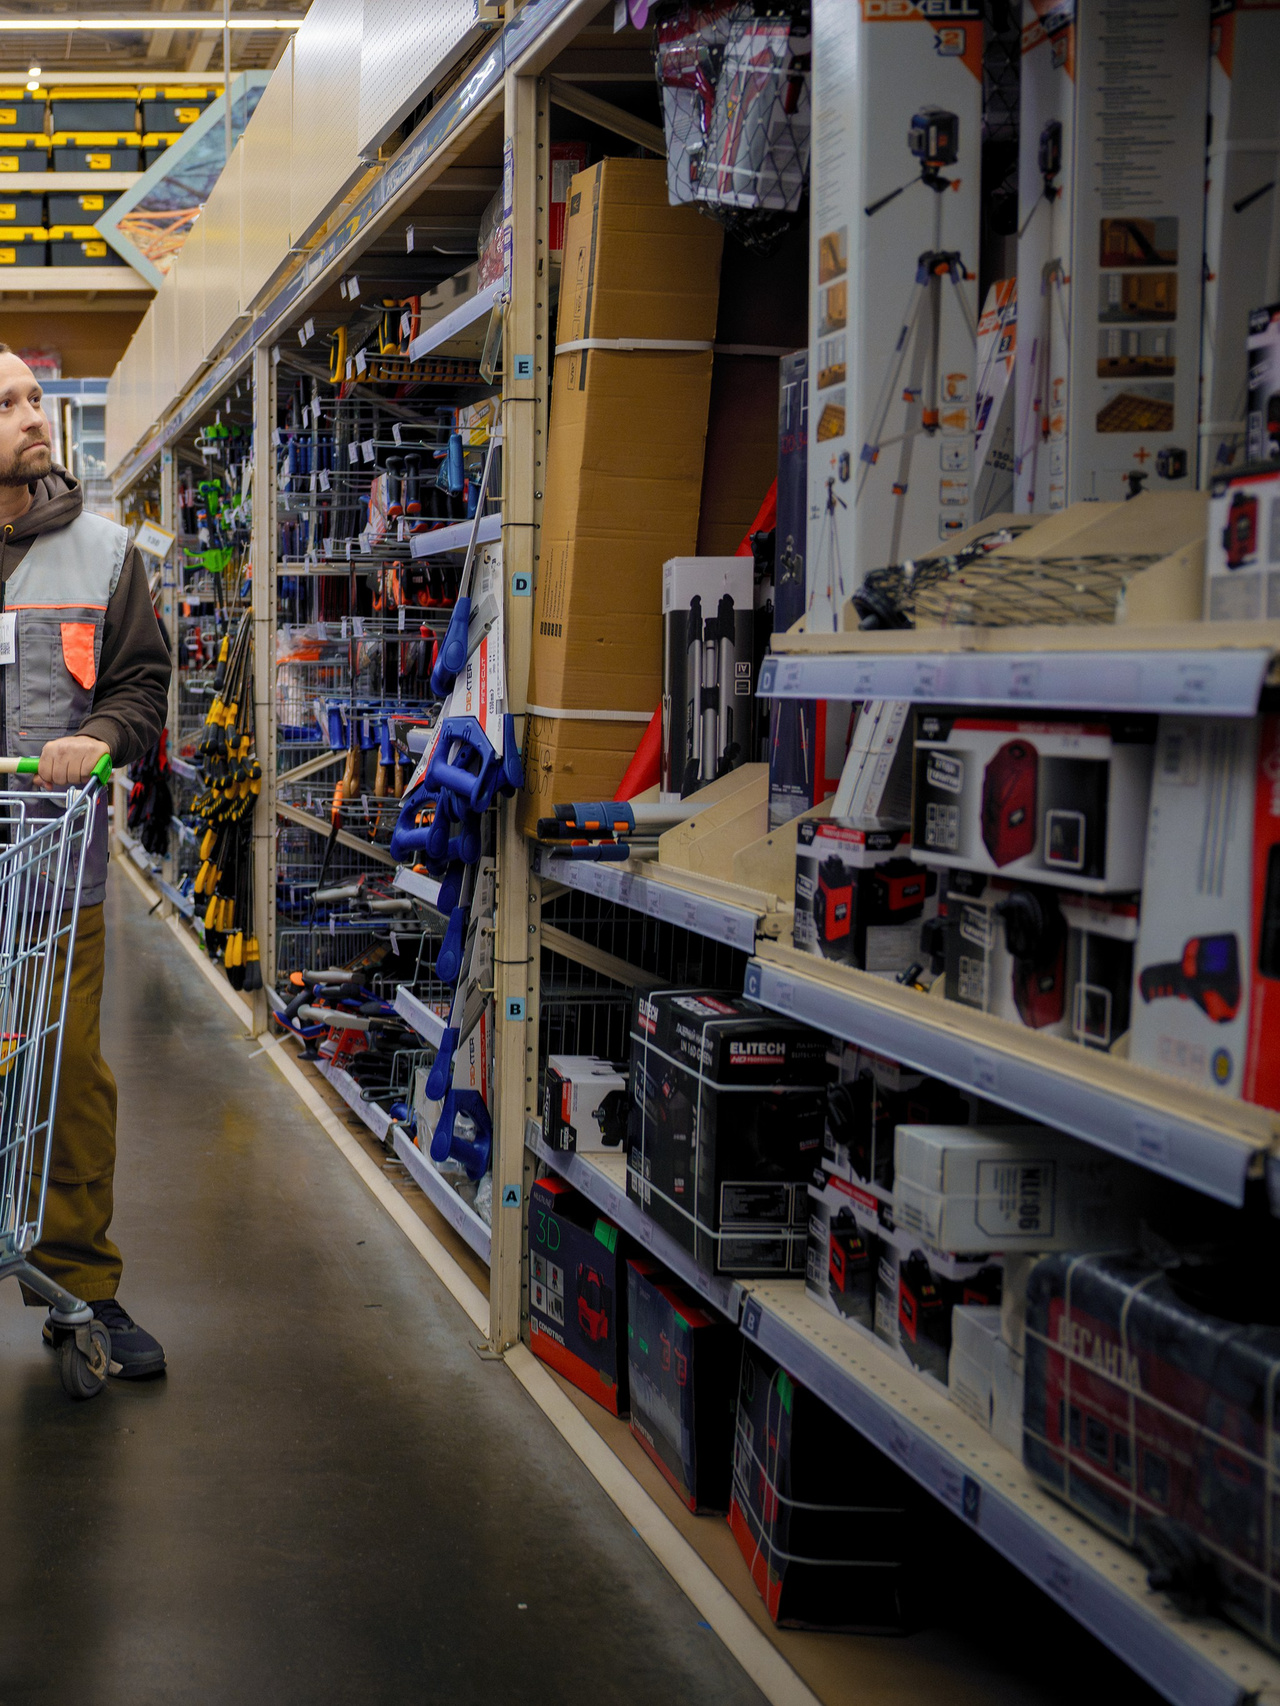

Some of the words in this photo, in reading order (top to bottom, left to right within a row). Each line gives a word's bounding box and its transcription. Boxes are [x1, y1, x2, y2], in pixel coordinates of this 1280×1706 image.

[518, 361, 529, 374] E
[515, 578, 528, 591] D
[465, 663, 474, 712] DEXTER
[763, 672, 771, 688] D
[748, 975, 757, 993] C
[510, 1003, 521, 1015] B
[729, 1041, 786, 1055] ELITECH
[731, 1056, 746, 1064] HD
[505, 1190, 518, 1203] A
[536, 1209, 561, 1251] 3D
[746, 1312, 755, 1330] B
[538, 1320, 566, 1346] CONDTROL
